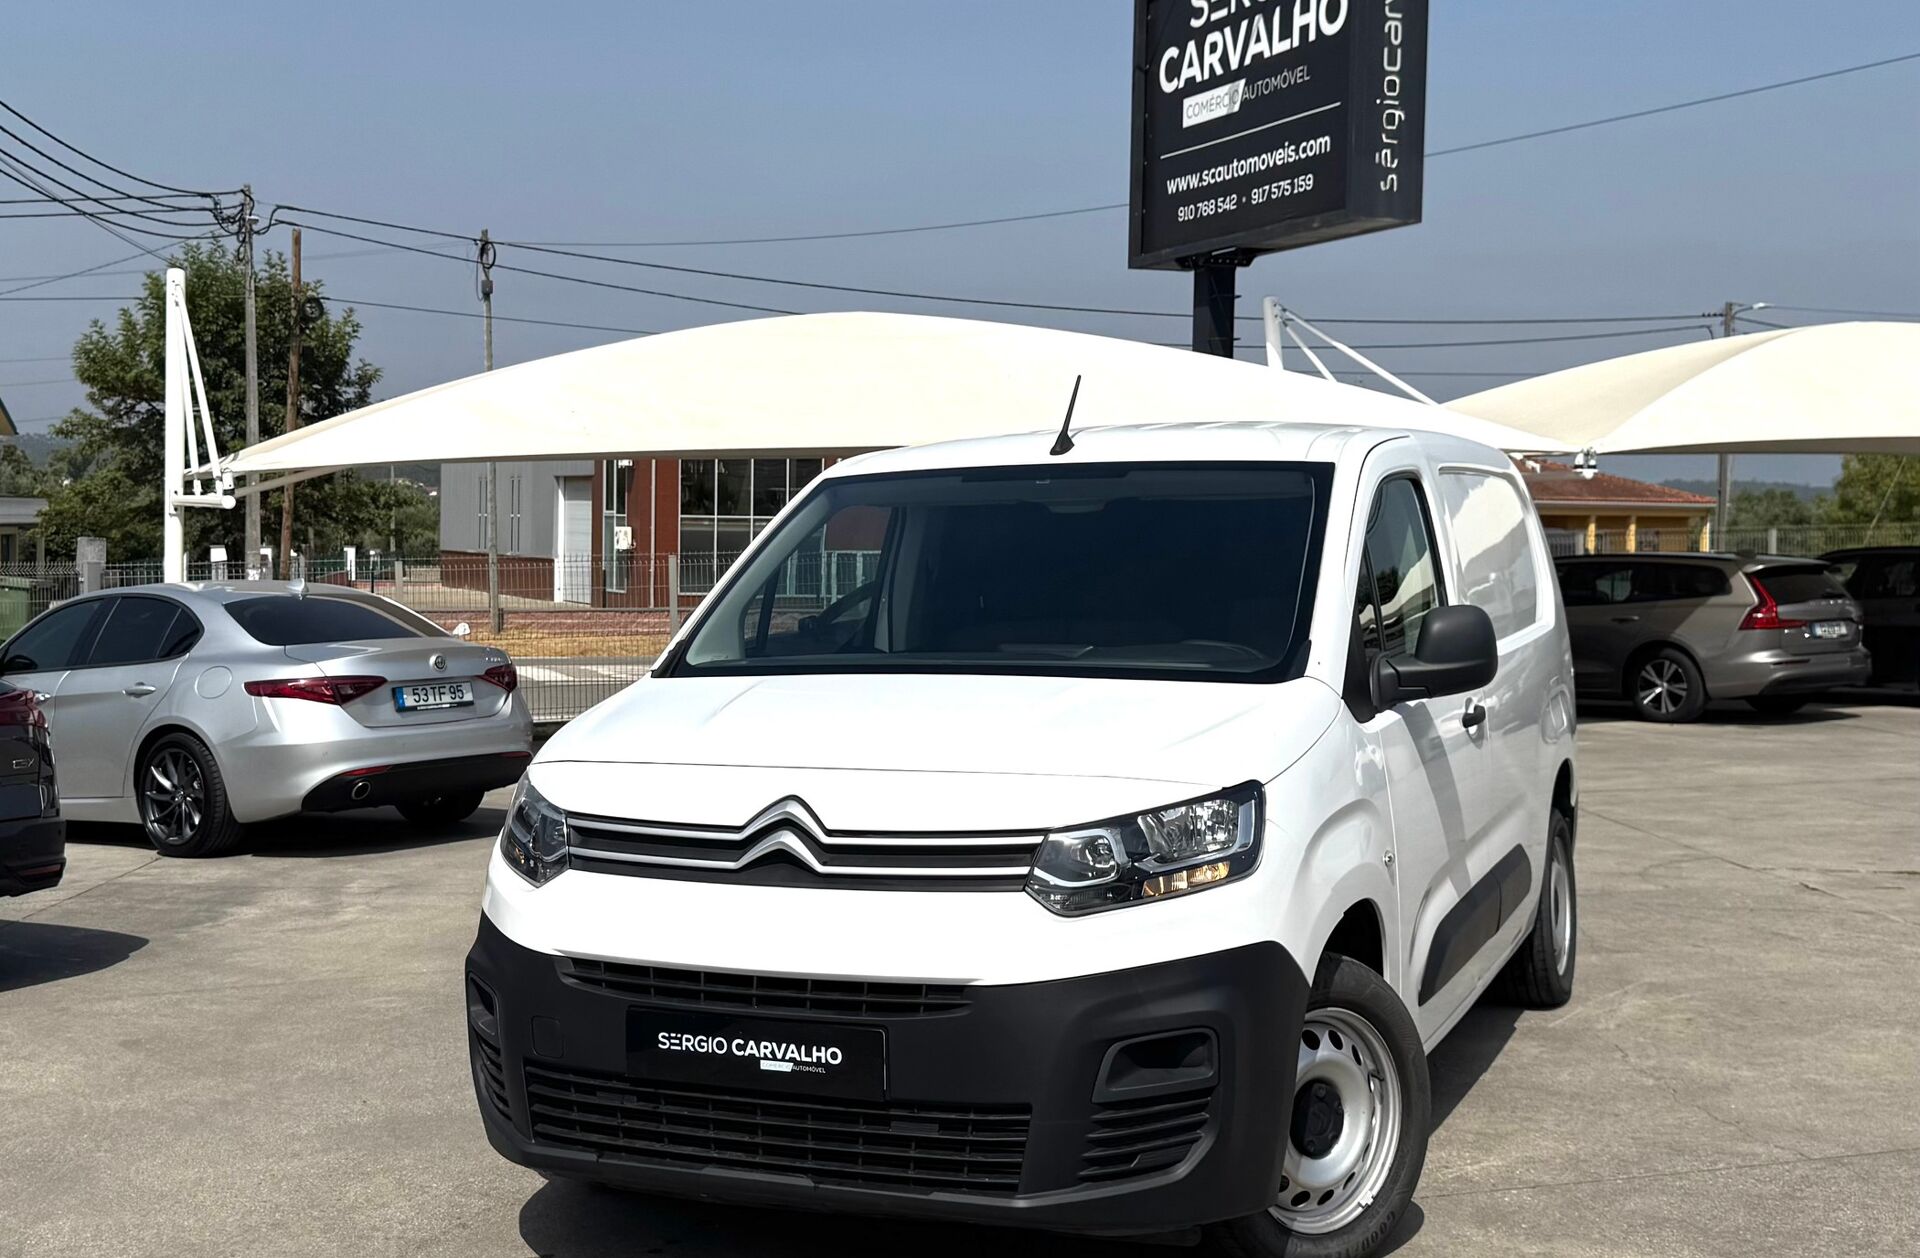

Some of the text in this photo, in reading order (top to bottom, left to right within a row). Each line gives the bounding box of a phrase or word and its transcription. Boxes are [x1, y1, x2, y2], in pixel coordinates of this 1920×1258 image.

[1159, 0, 1348, 93] CARVALHO
[1186, 65, 1311, 119] COMÉRCIO AUTOMÓVEL
[1166, 135, 1331, 195] www.scautomoveis.com
[1177, 173, 1314, 222] 910 768 542 917 575 159
[412, 684, 464, 703] 53 TF 95
[731, 1038, 842, 1065] CARVALHO
